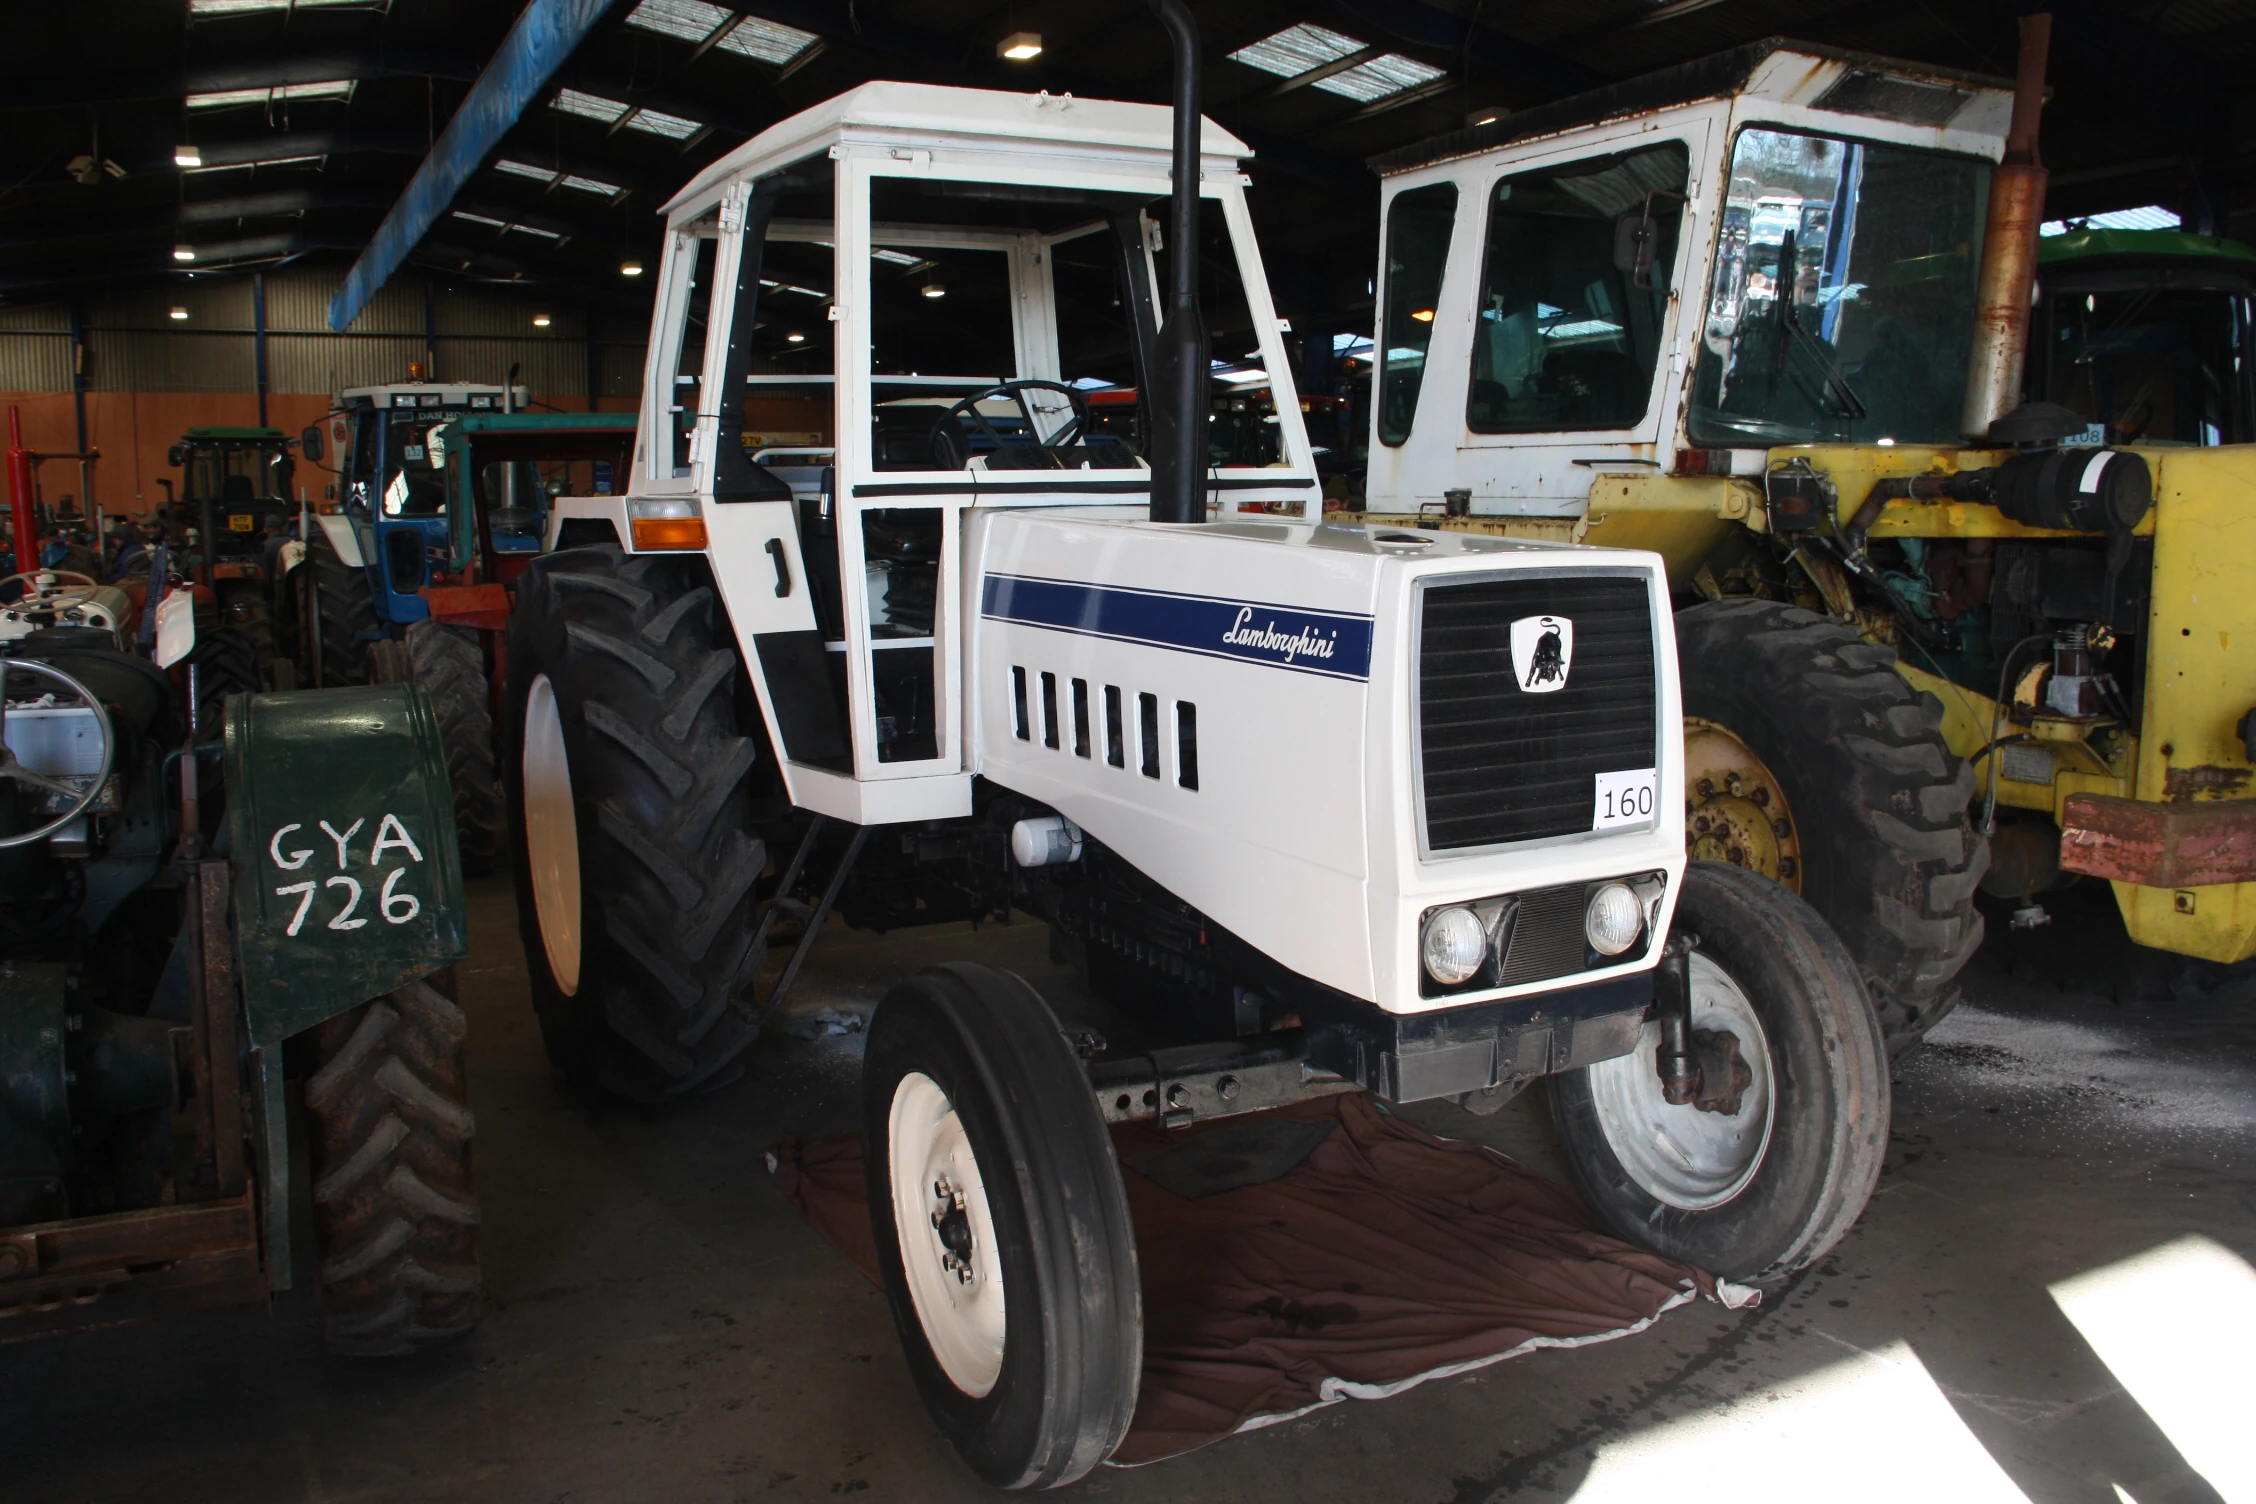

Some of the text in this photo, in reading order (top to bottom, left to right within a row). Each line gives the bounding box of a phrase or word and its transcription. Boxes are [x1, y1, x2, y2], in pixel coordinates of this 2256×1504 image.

[418, 411, 443, 420] DAN
[1222, 606, 1337, 662] Lamborghini
[1603, 786, 1653, 819] 160
[270, 813, 424, 870] GYA
[276, 867, 420, 937] 726
